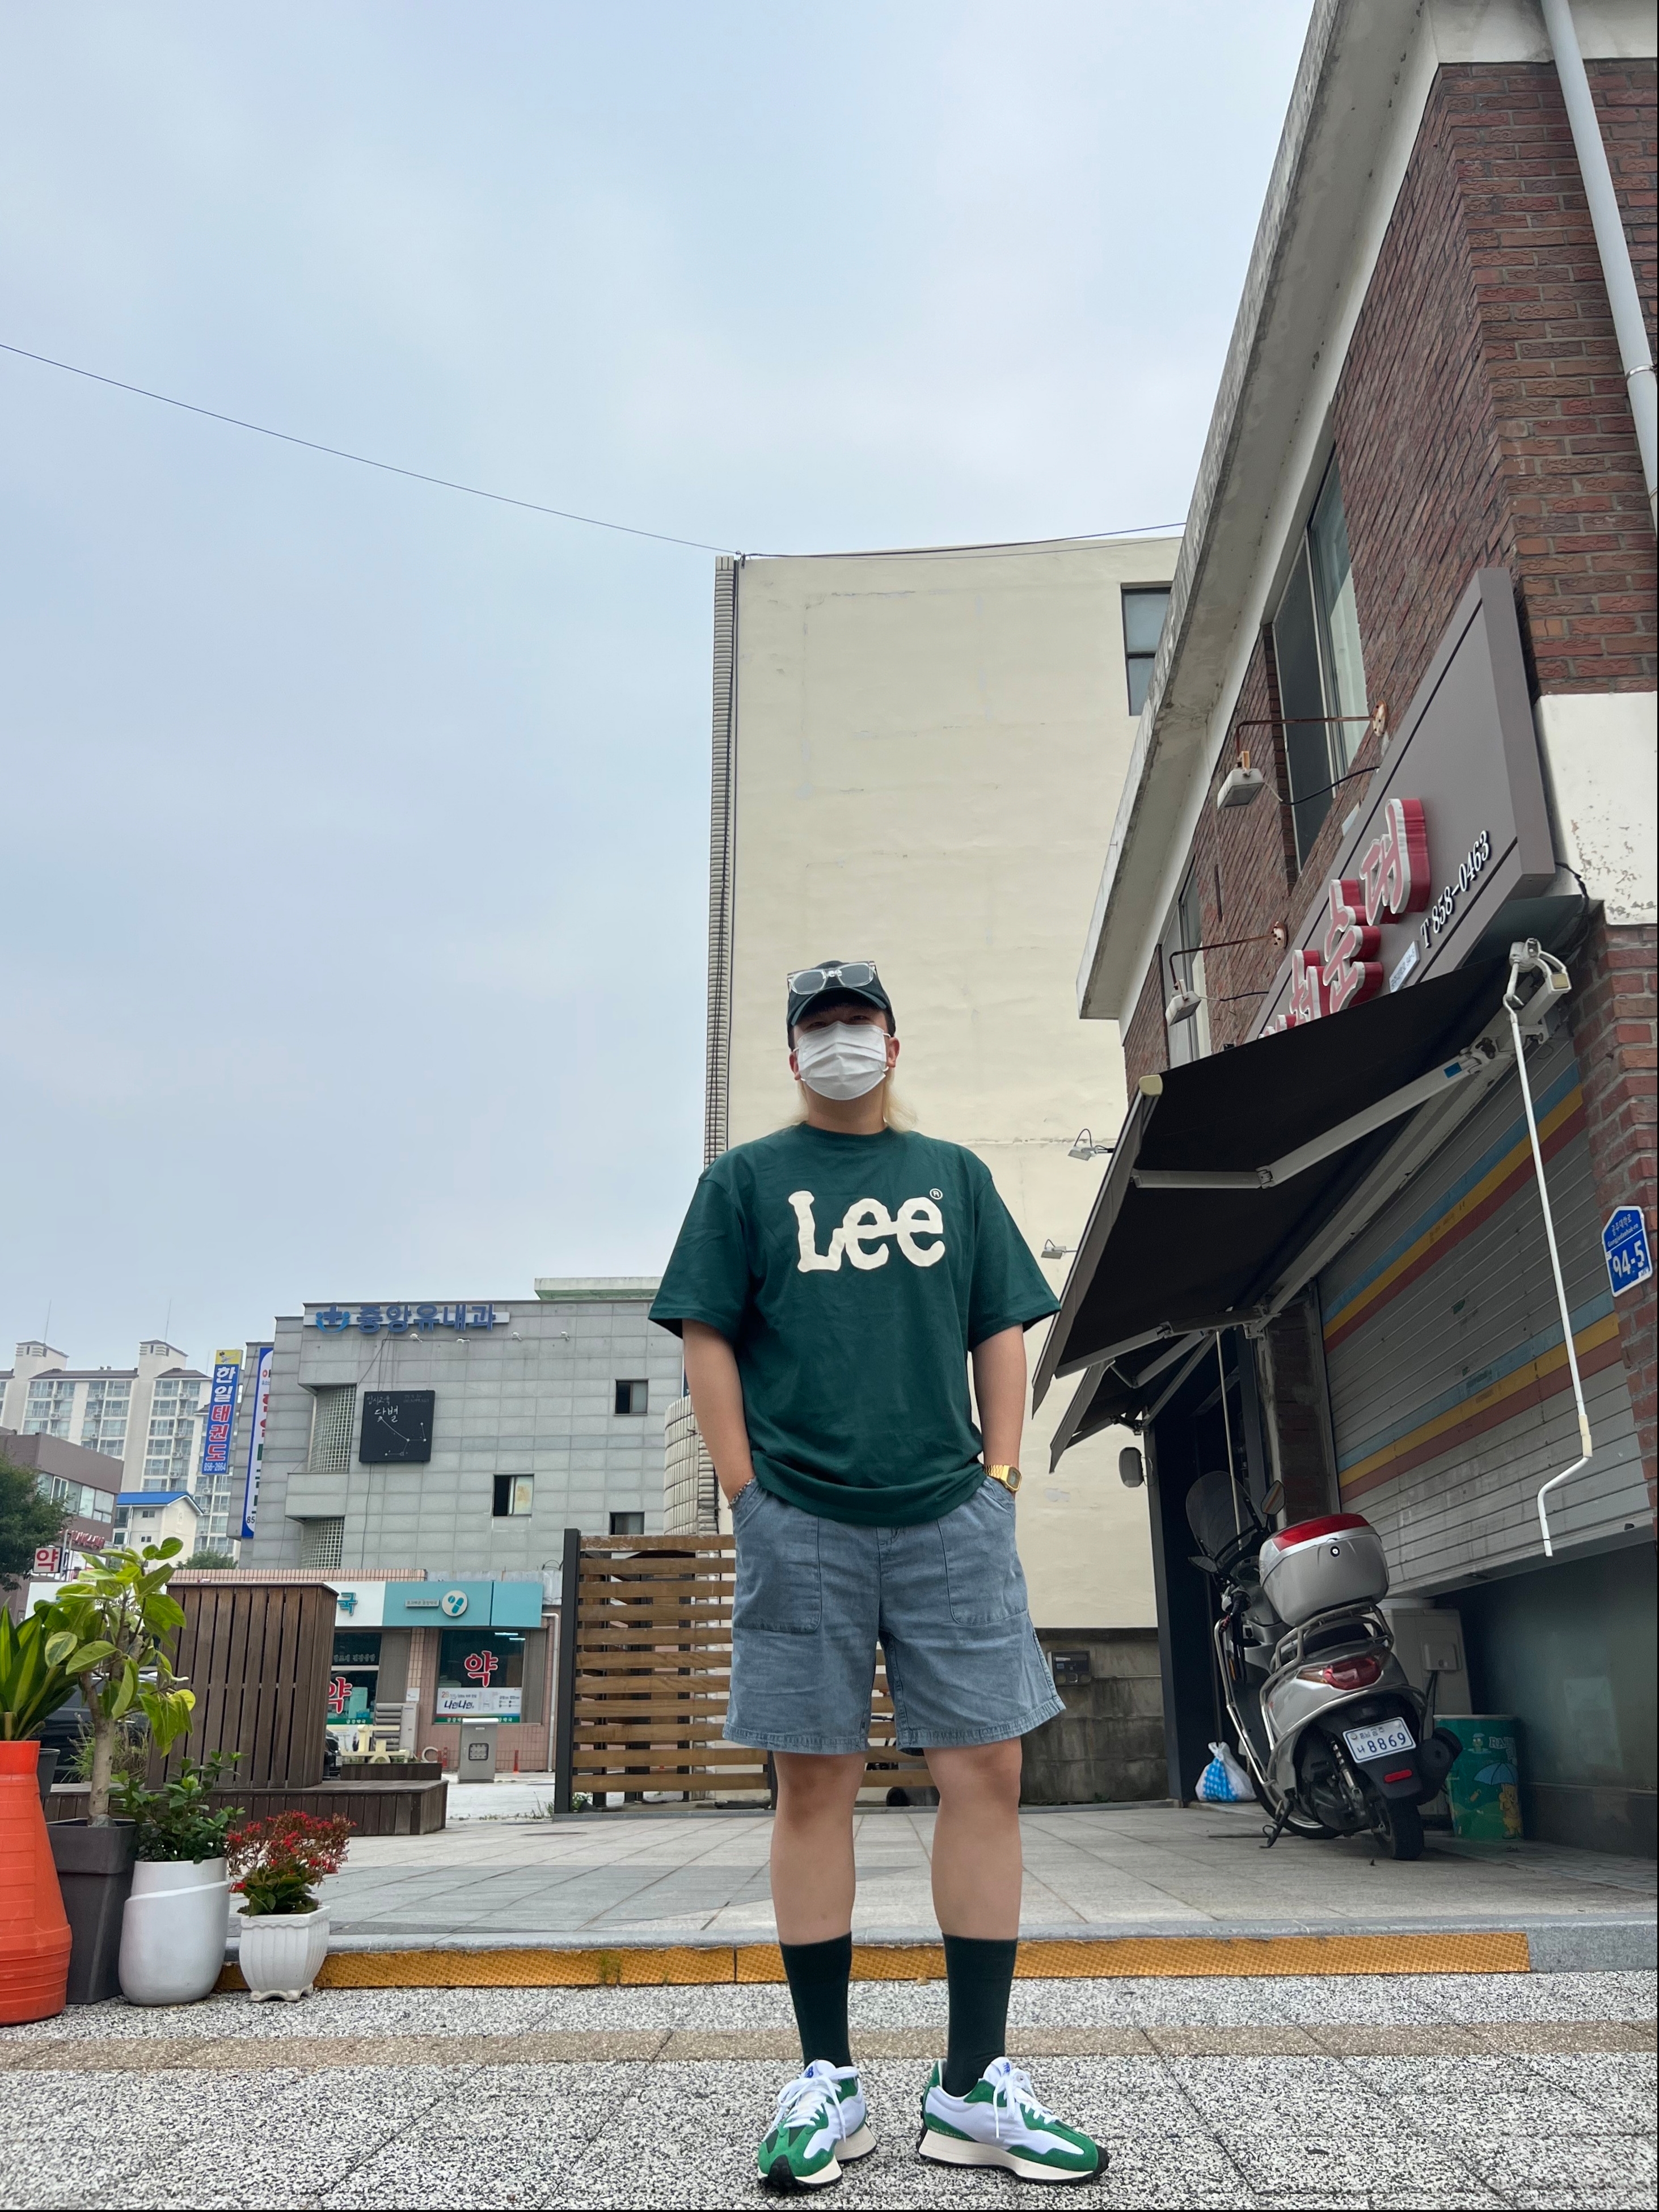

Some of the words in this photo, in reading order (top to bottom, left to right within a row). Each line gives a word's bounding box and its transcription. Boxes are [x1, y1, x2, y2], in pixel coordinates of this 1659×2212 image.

[1420, 918, 1430, 949] T
[1432, 830, 1490, 934] 858-0463
[1259, 798, 1421, 1039] 천순대
[788, 1189, 945, 1273] Lee
[1611, 1213, 1632, 1236] 공주대학로
[1612, 1239, 1645, 1278] 94-5
[356, 1303, 496, 1333] 중앙유내과
[204, 1462, 227, 1472] 856-2664
[36, 1548, 59, 1572] 약
[464, 1650, 499, 1688] 약
[1367, 1732, 1406, 1753] 8869
